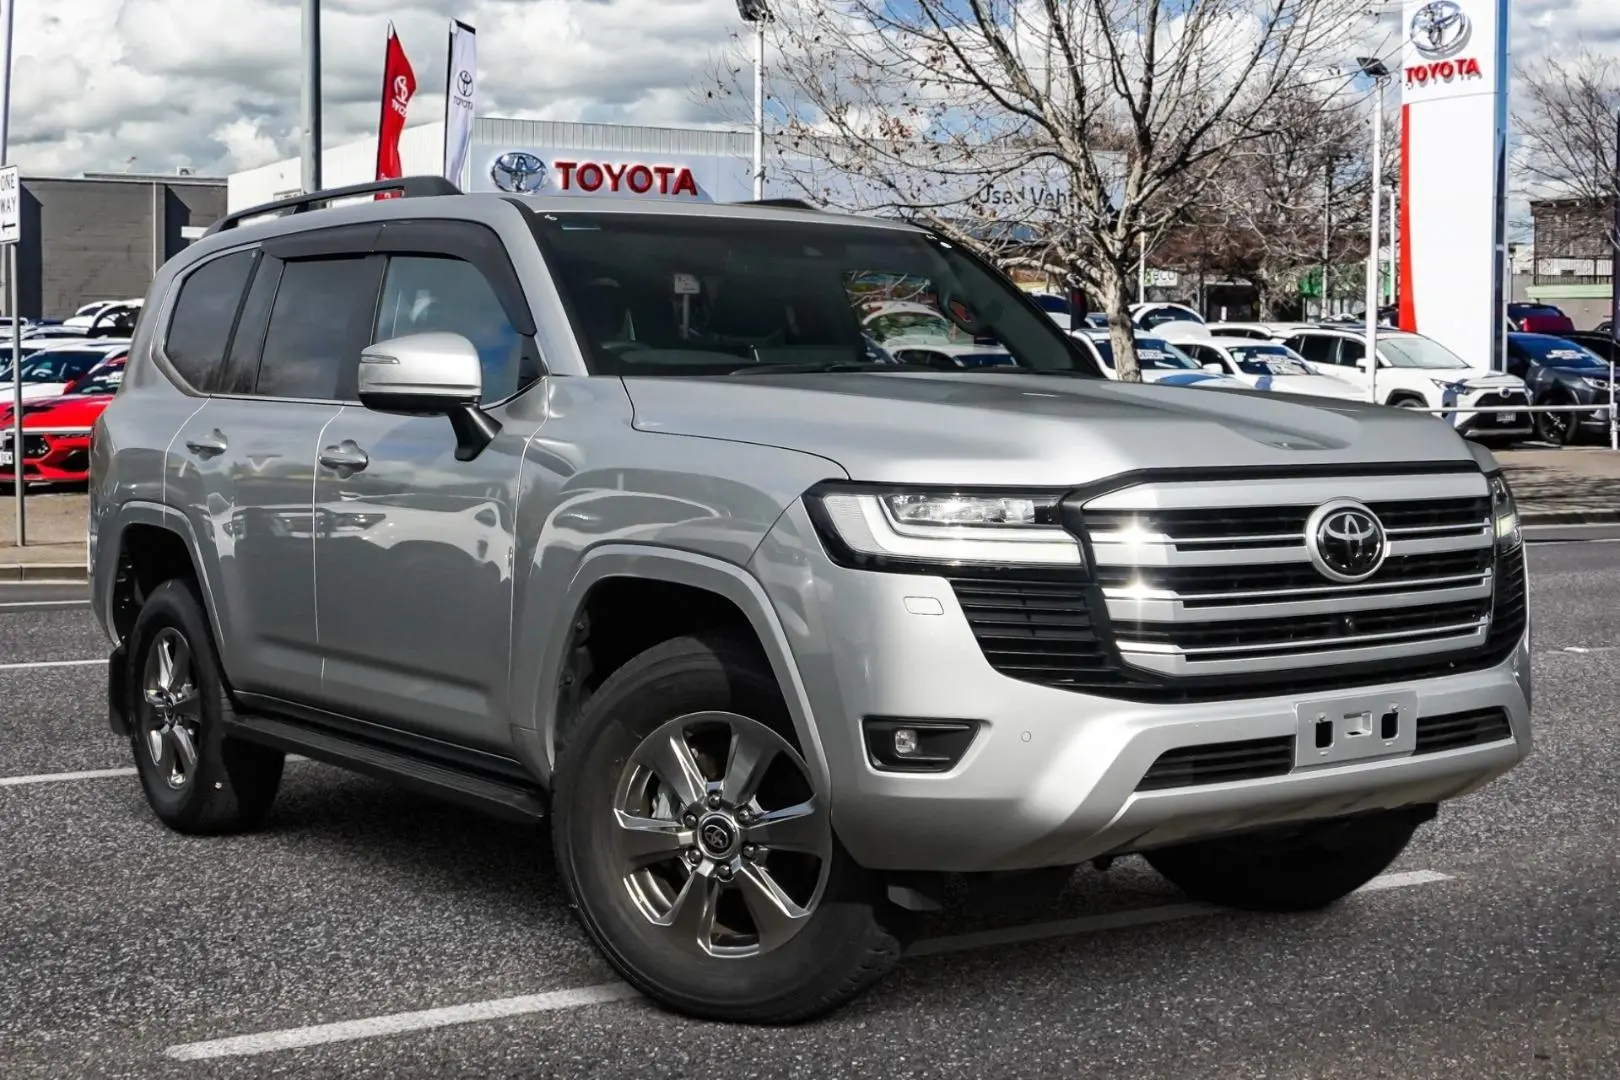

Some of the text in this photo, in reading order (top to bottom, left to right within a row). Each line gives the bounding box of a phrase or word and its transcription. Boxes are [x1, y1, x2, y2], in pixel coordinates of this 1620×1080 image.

[1404, 58, 1480, 83] TOYOTA
[1, 173, 15, 191] ONE
[555, 162, 698, 196] TOYOTA
[0, 196, 16, 213] WAY
